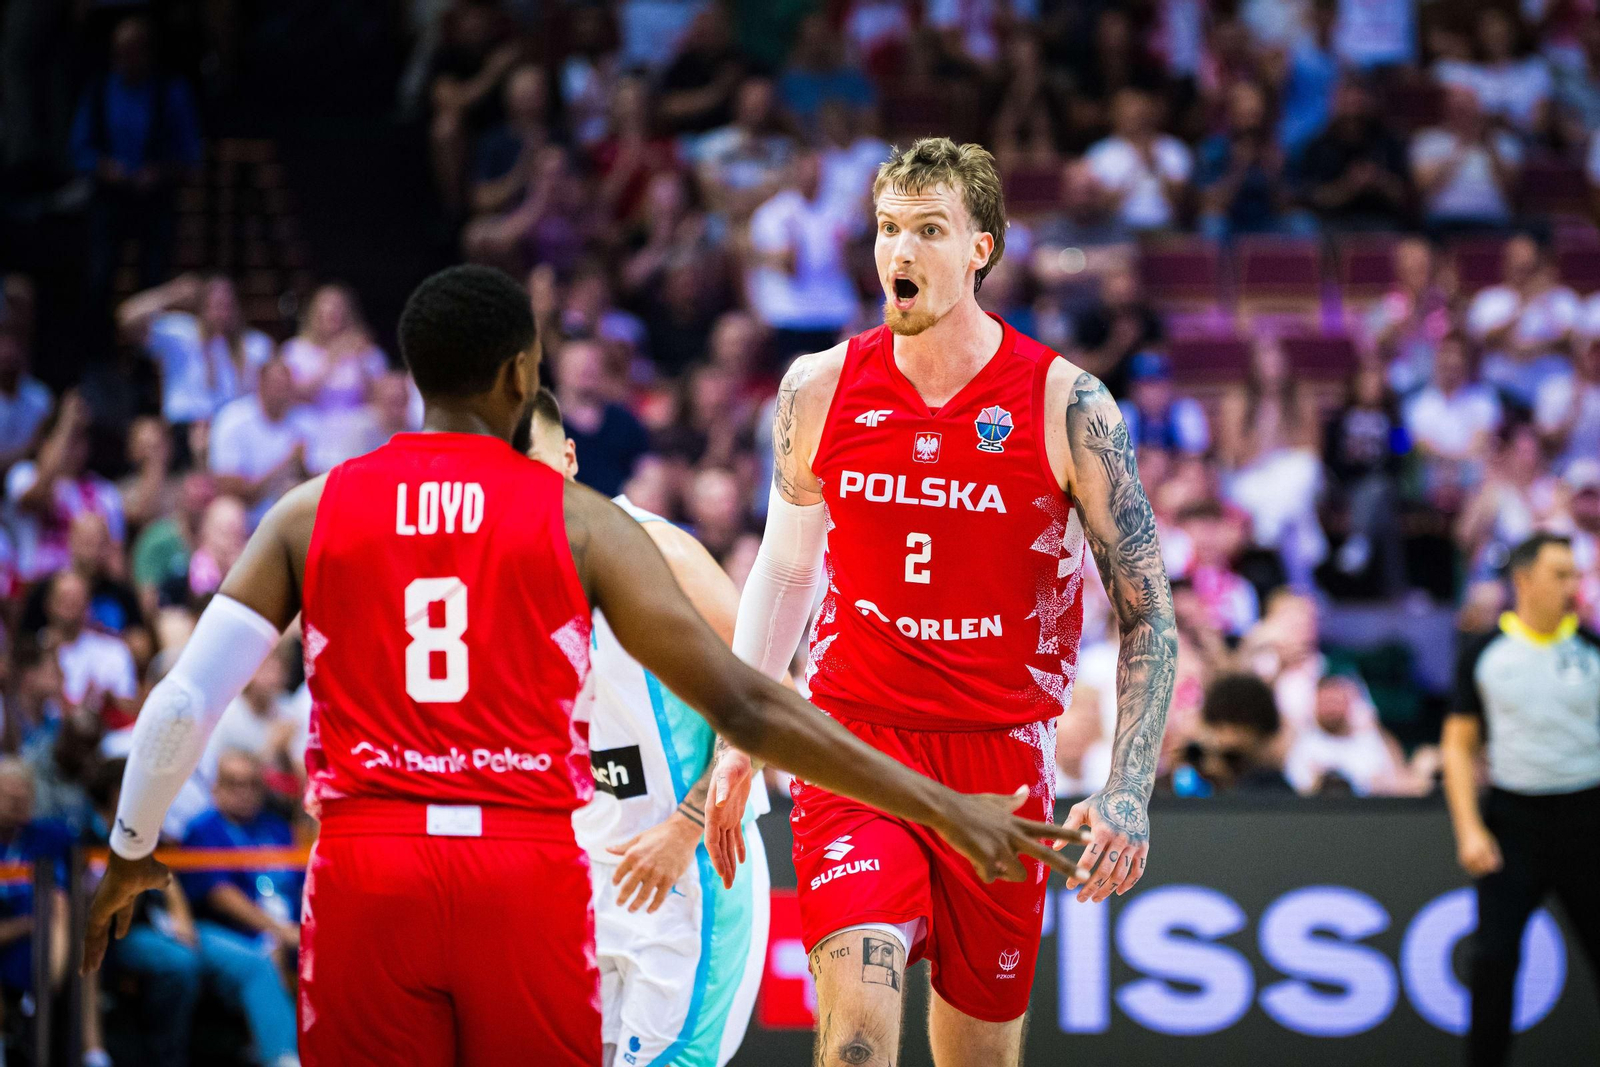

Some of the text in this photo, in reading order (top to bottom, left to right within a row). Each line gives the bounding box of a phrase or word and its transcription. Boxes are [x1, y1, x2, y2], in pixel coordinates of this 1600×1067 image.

[855, 410, 893, 427] 4F
[839, 470, 1007, 514] POLSKA
[396, 481, 485, 535] LOYD
[904, 532, 932, 585] 2
[404, 576, 469, 703] 8
[895, 615, 1003, 641] ORLEN
[404, 747, 552, 773] Bank Pekao
[1090, 843, 1145, 869] LOVE
[811, 859, 880, 890] SUZUKI
[830, 946, 850, 960] VICI
[1040, 884, 1567, 1036] ISSO
